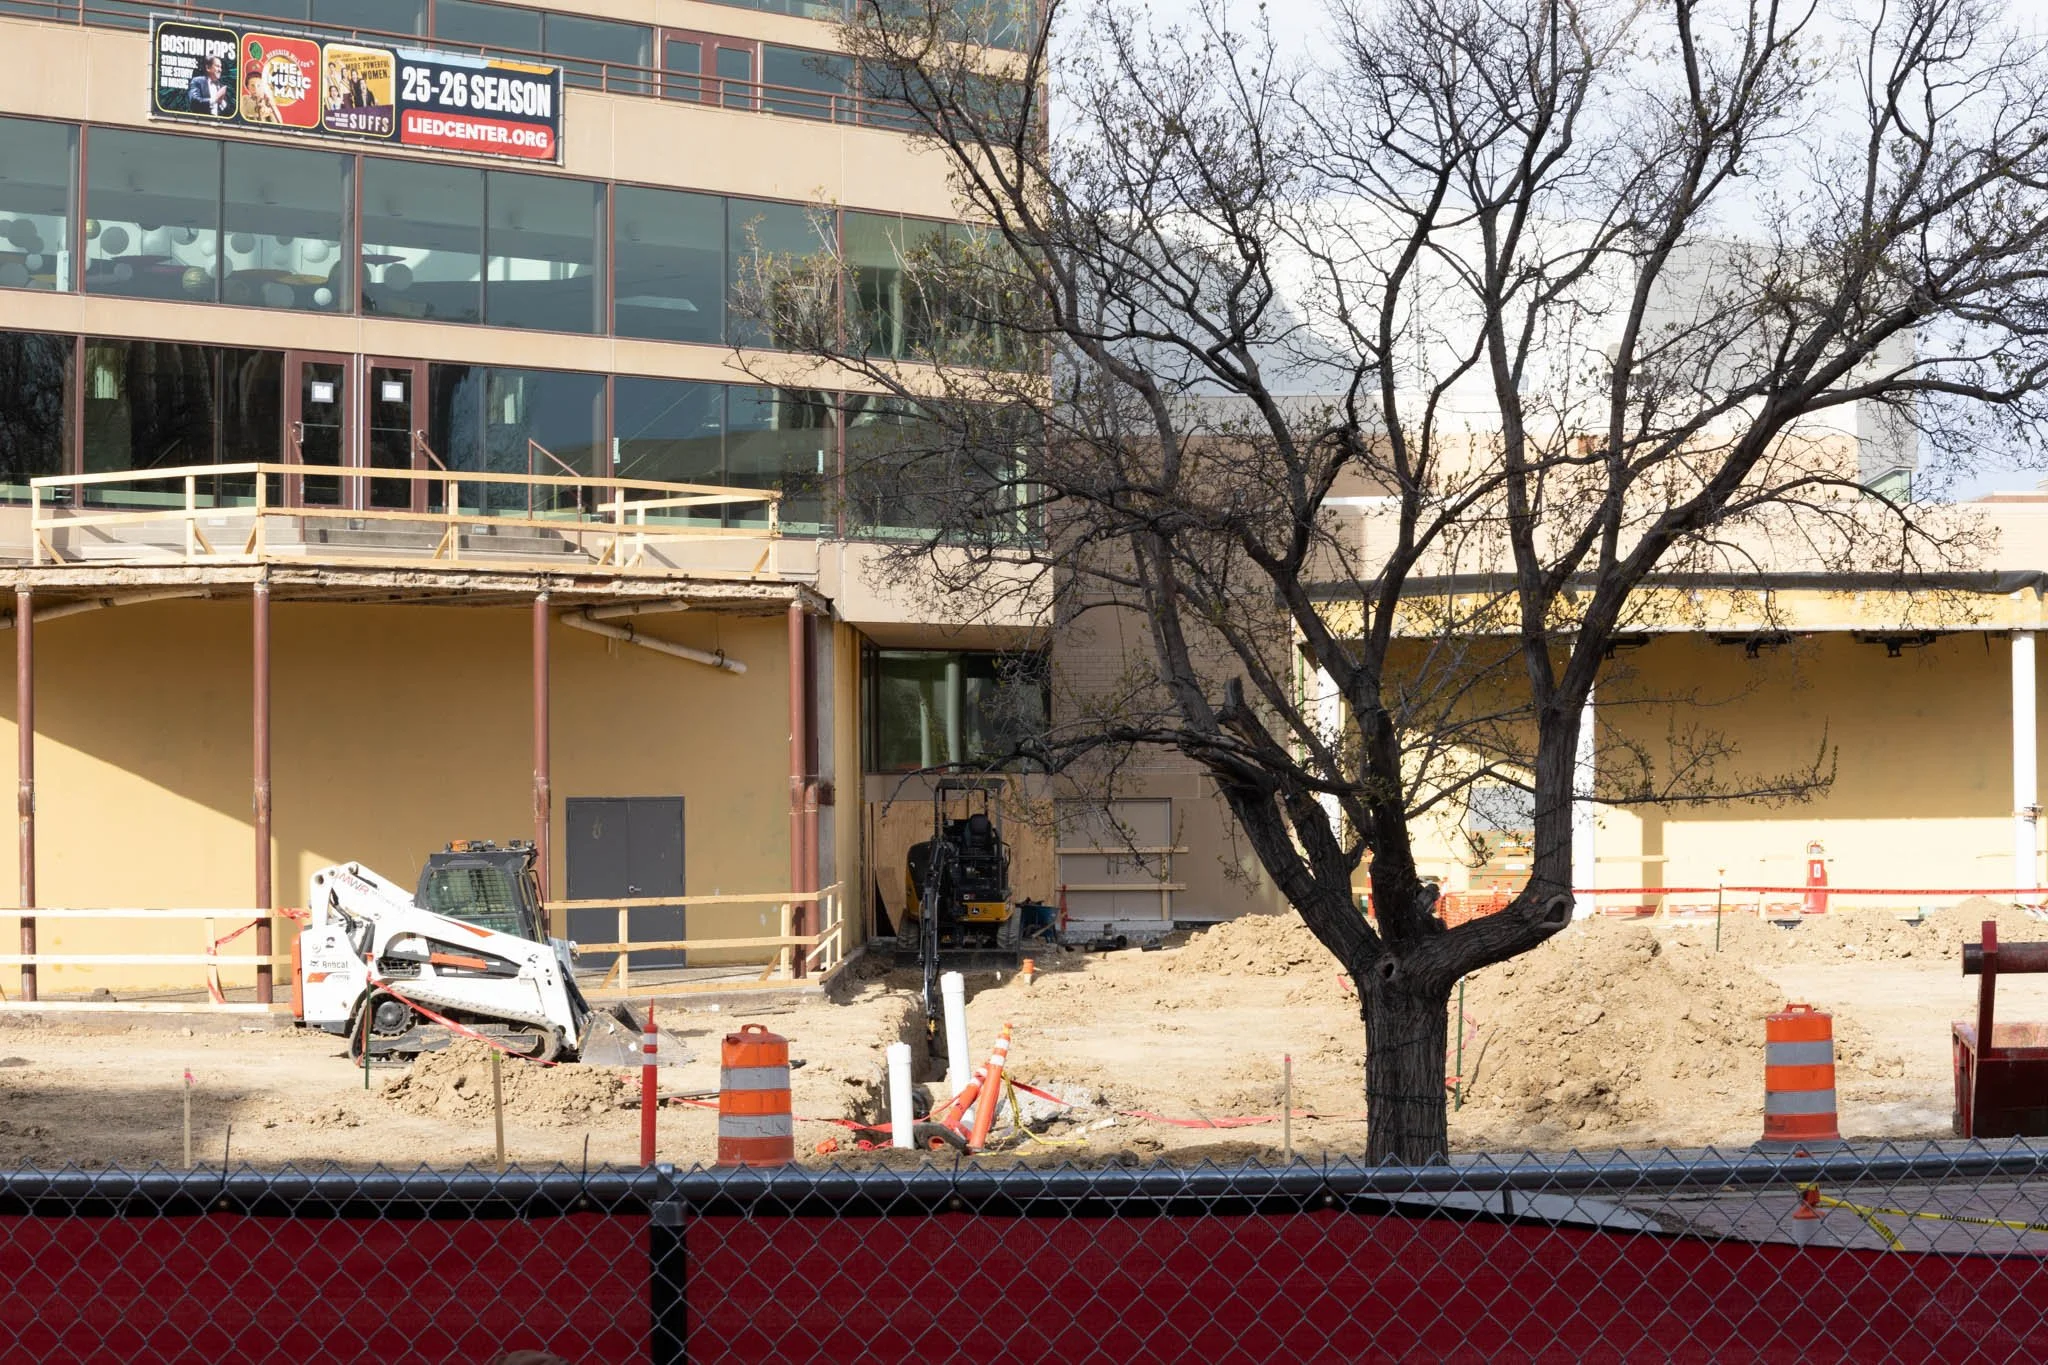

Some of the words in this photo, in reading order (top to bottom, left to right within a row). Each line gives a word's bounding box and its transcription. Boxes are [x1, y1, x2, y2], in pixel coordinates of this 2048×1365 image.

[161, 34, 204, 56] BOSTON
[206, 39, 236, 60] POPS
[161, 66, 173, 76] THE
[271, 62, 297, 73] THE
[363, 60, 390, 69] POWERFUL
[268, 73, 312, 89] MUSIC
[274, 86, 305, 101] MAN
[401, 66, 468, 107] 25-26
[470, 74, 552, 118] SEASON
[349, 113, 390, 132] SUFFS
[407, 116, 548, 148] LIEDCENTER.ORG
